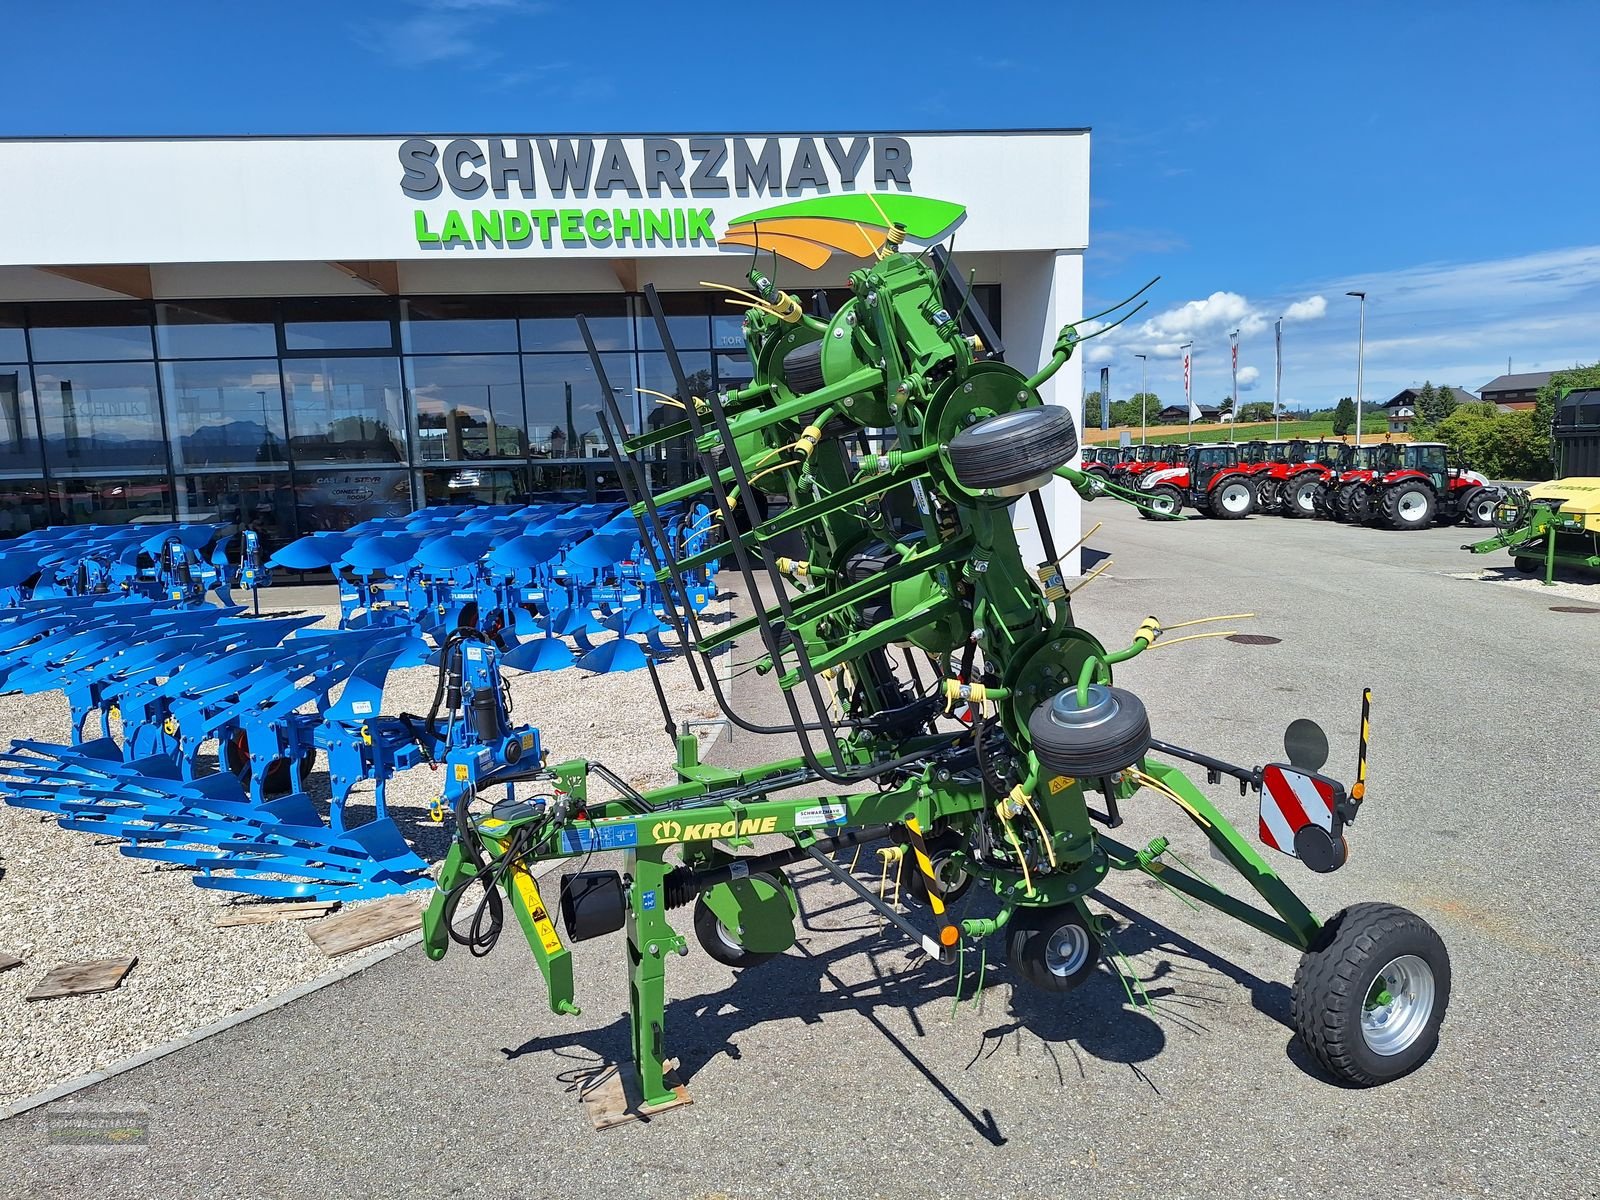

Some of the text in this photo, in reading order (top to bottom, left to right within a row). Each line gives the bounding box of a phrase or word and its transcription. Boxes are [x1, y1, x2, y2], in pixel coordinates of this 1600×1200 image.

[397, 136, 912, 197] SCHWARZMAYR
[415, 207, 717, 246] LANDTECHNIK
[682, 816, 778, 841] KRONE
